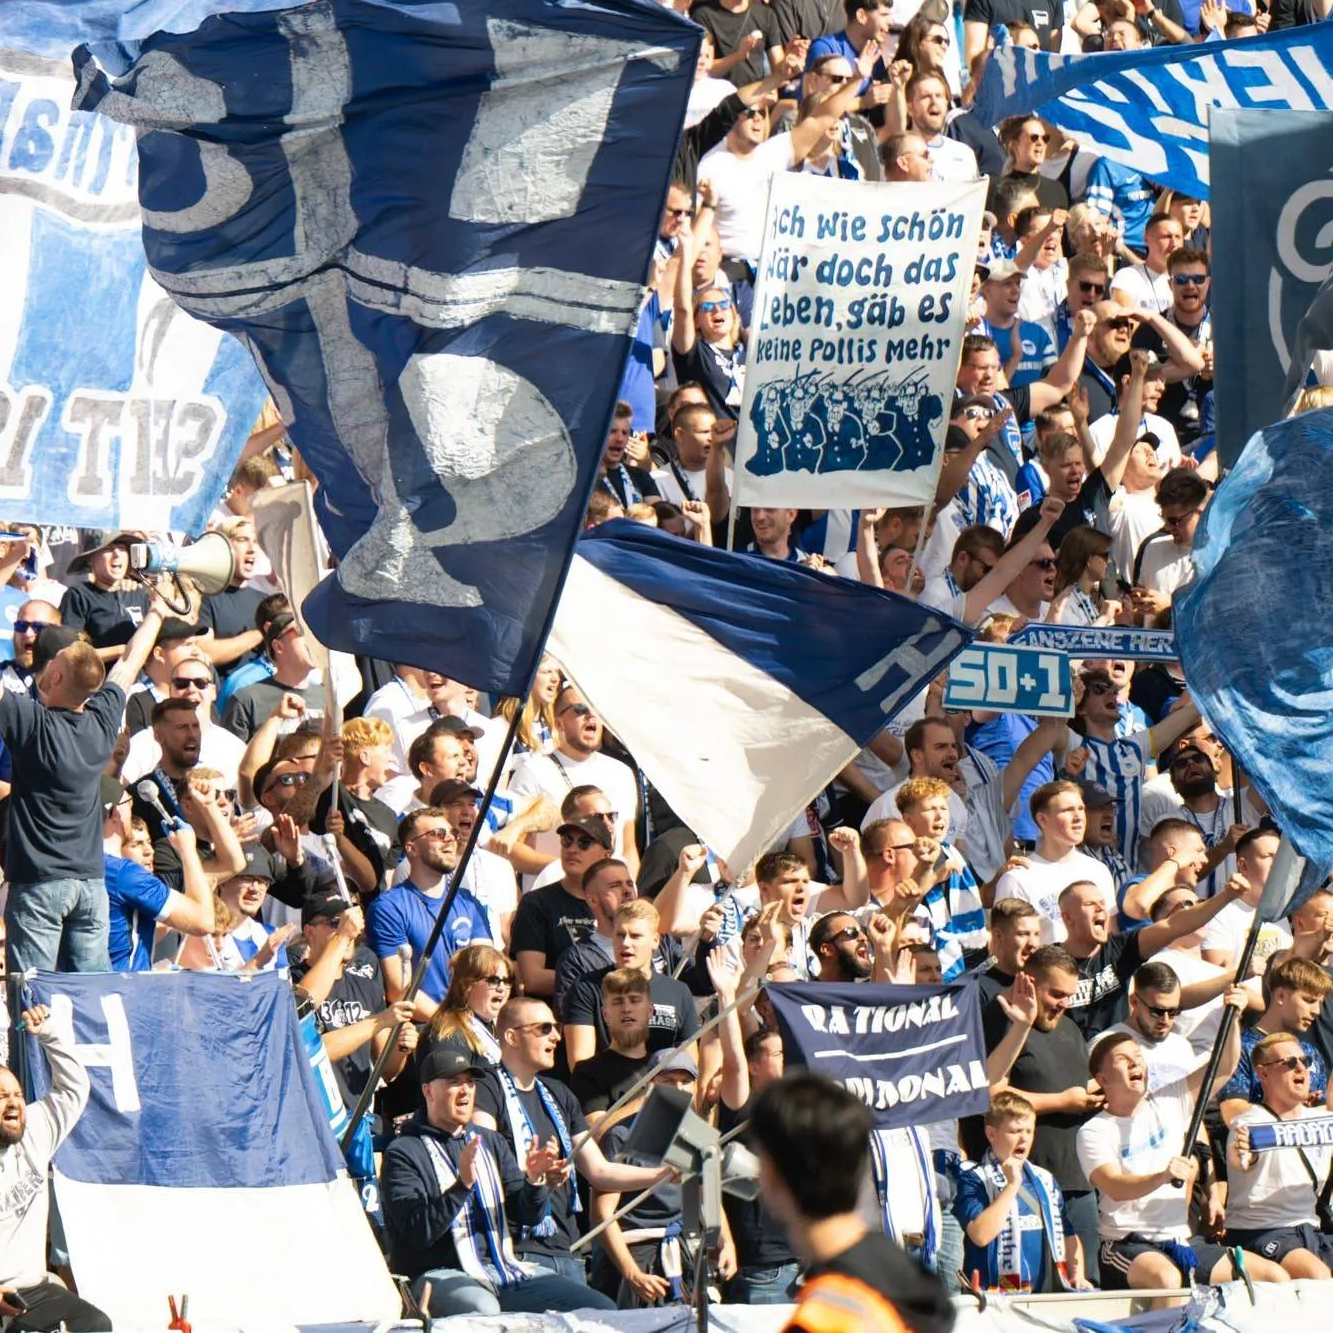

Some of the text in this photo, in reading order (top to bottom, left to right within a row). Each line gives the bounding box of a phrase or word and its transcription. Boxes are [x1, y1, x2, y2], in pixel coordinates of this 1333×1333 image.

[877, 207, 965, 243] schön
[815, 252, 891, 287] doch
[904, 251, 960, 284] das
[847, 292, 905, 330] gäb
[917, 291, 953, 323] es
[1129, 633, 1174, 654] HER
[948, 650, 1069, 708] 50+1
[50, 994, 141, 1112] H
